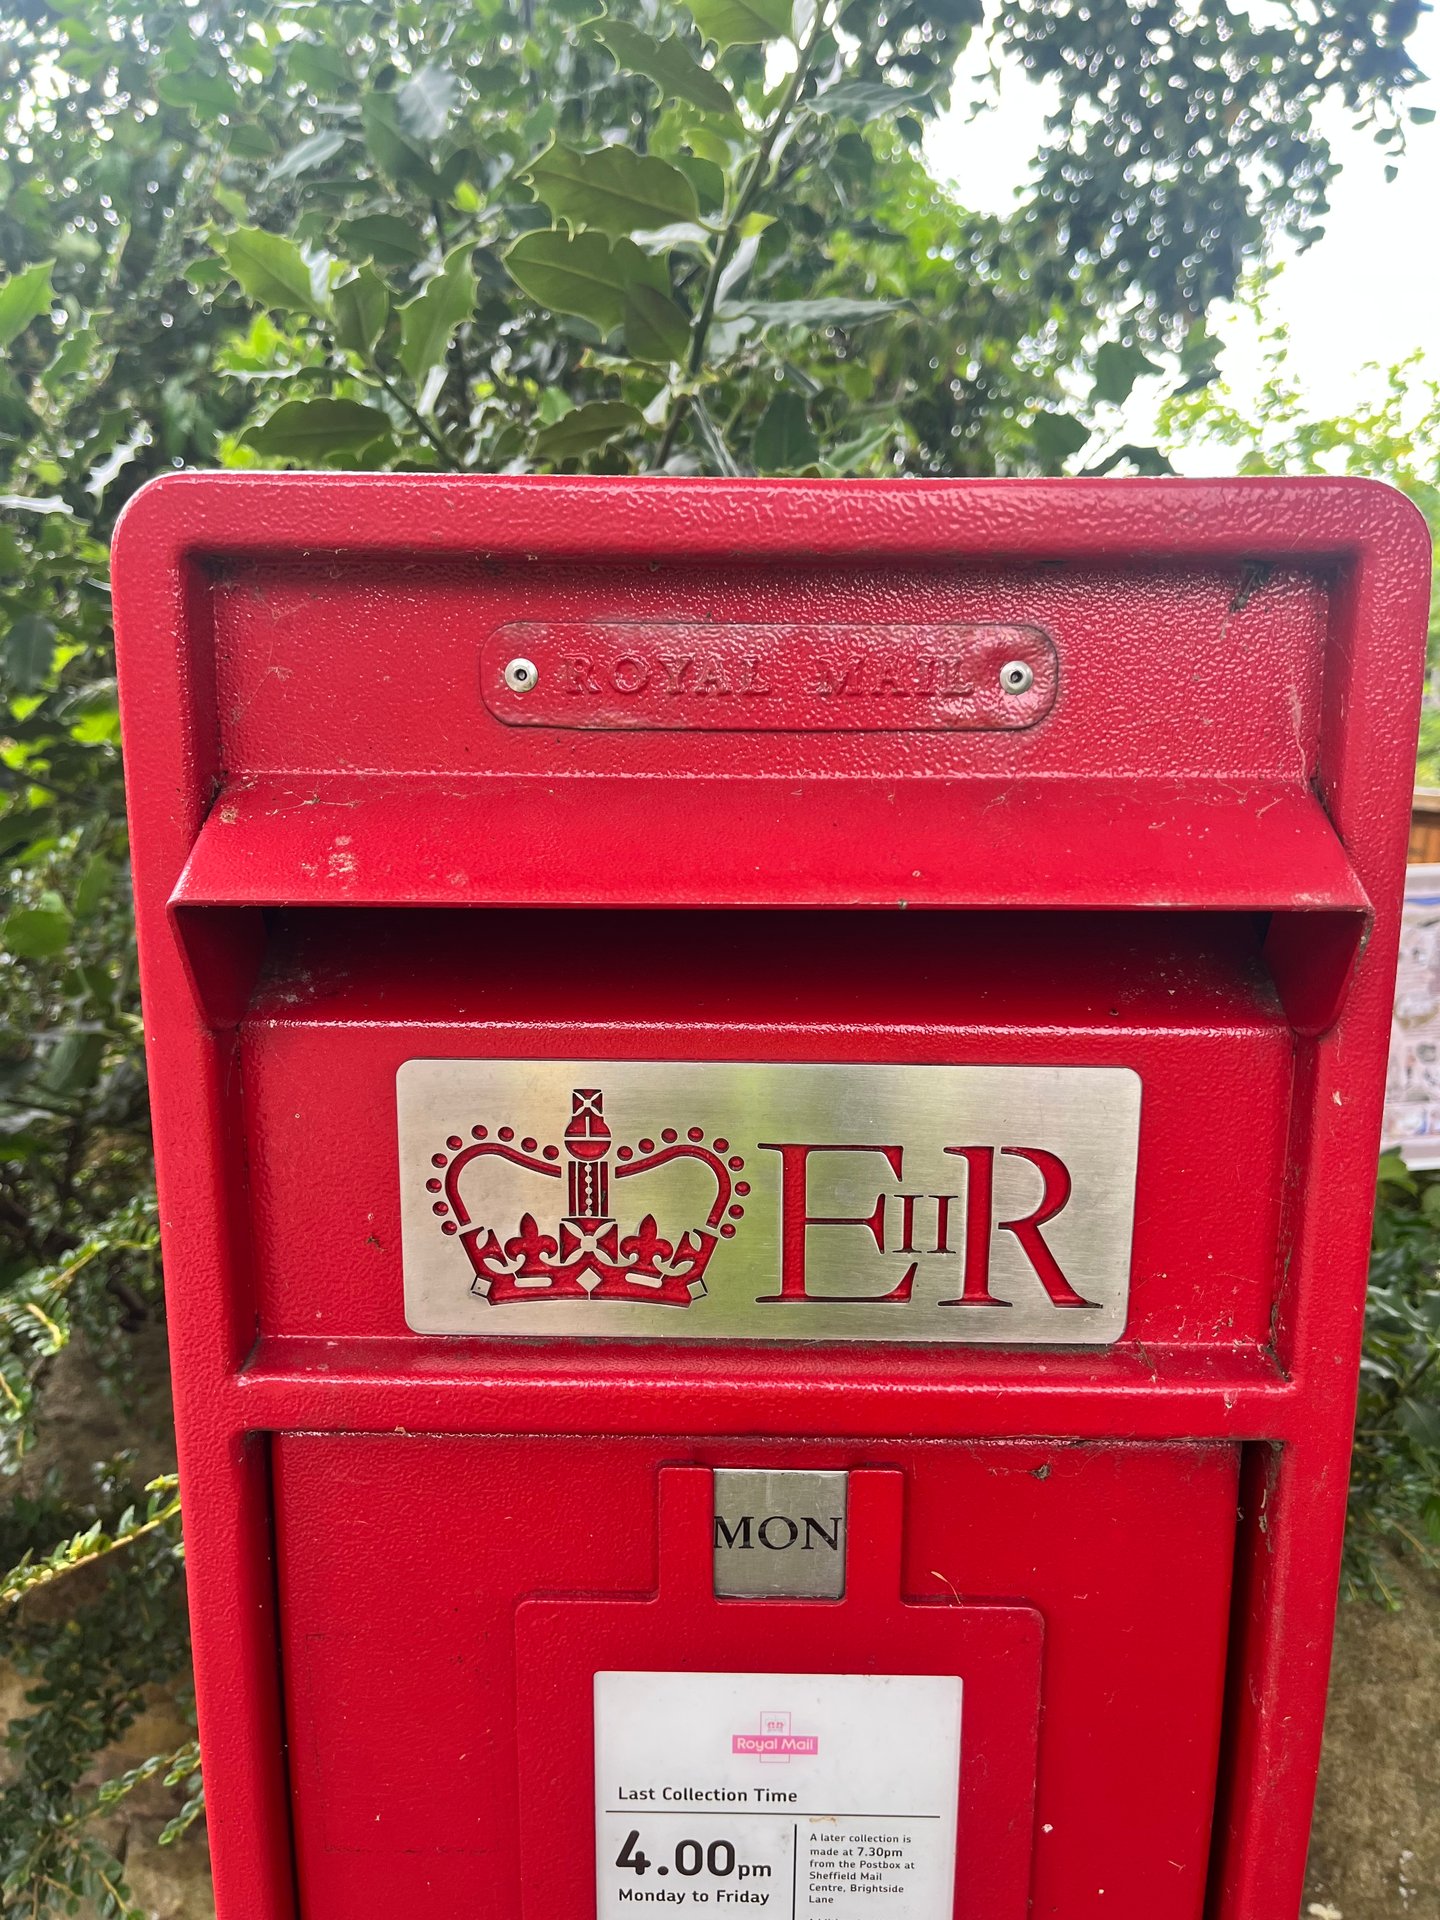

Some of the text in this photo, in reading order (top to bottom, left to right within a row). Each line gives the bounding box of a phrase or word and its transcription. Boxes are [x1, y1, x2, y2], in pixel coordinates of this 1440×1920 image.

[562, 652, 976, 697] ROYAL MAIL
[713, 1515, 843, 1551] MON
[736, 1737, 814, 1752] Royal Mail
[618, 1786, 798, 1803] Last Collection Time
[809, 1833, 912, 1844] A later collection is
[615, 1830, 772, 1881] 4.00pm
[809, 1846, 903, 1859] made at 7.30pm
[809, 1859, 915, 1870] from the Postbox at
[809, 1871, 882, 1881] Sheffield Mail
[808, 1882, 904, 1894] Centre, Brightside
[618, 1888, 770, 1906] Monday to Friday
[808, 1895, 834, 1904] Lane
